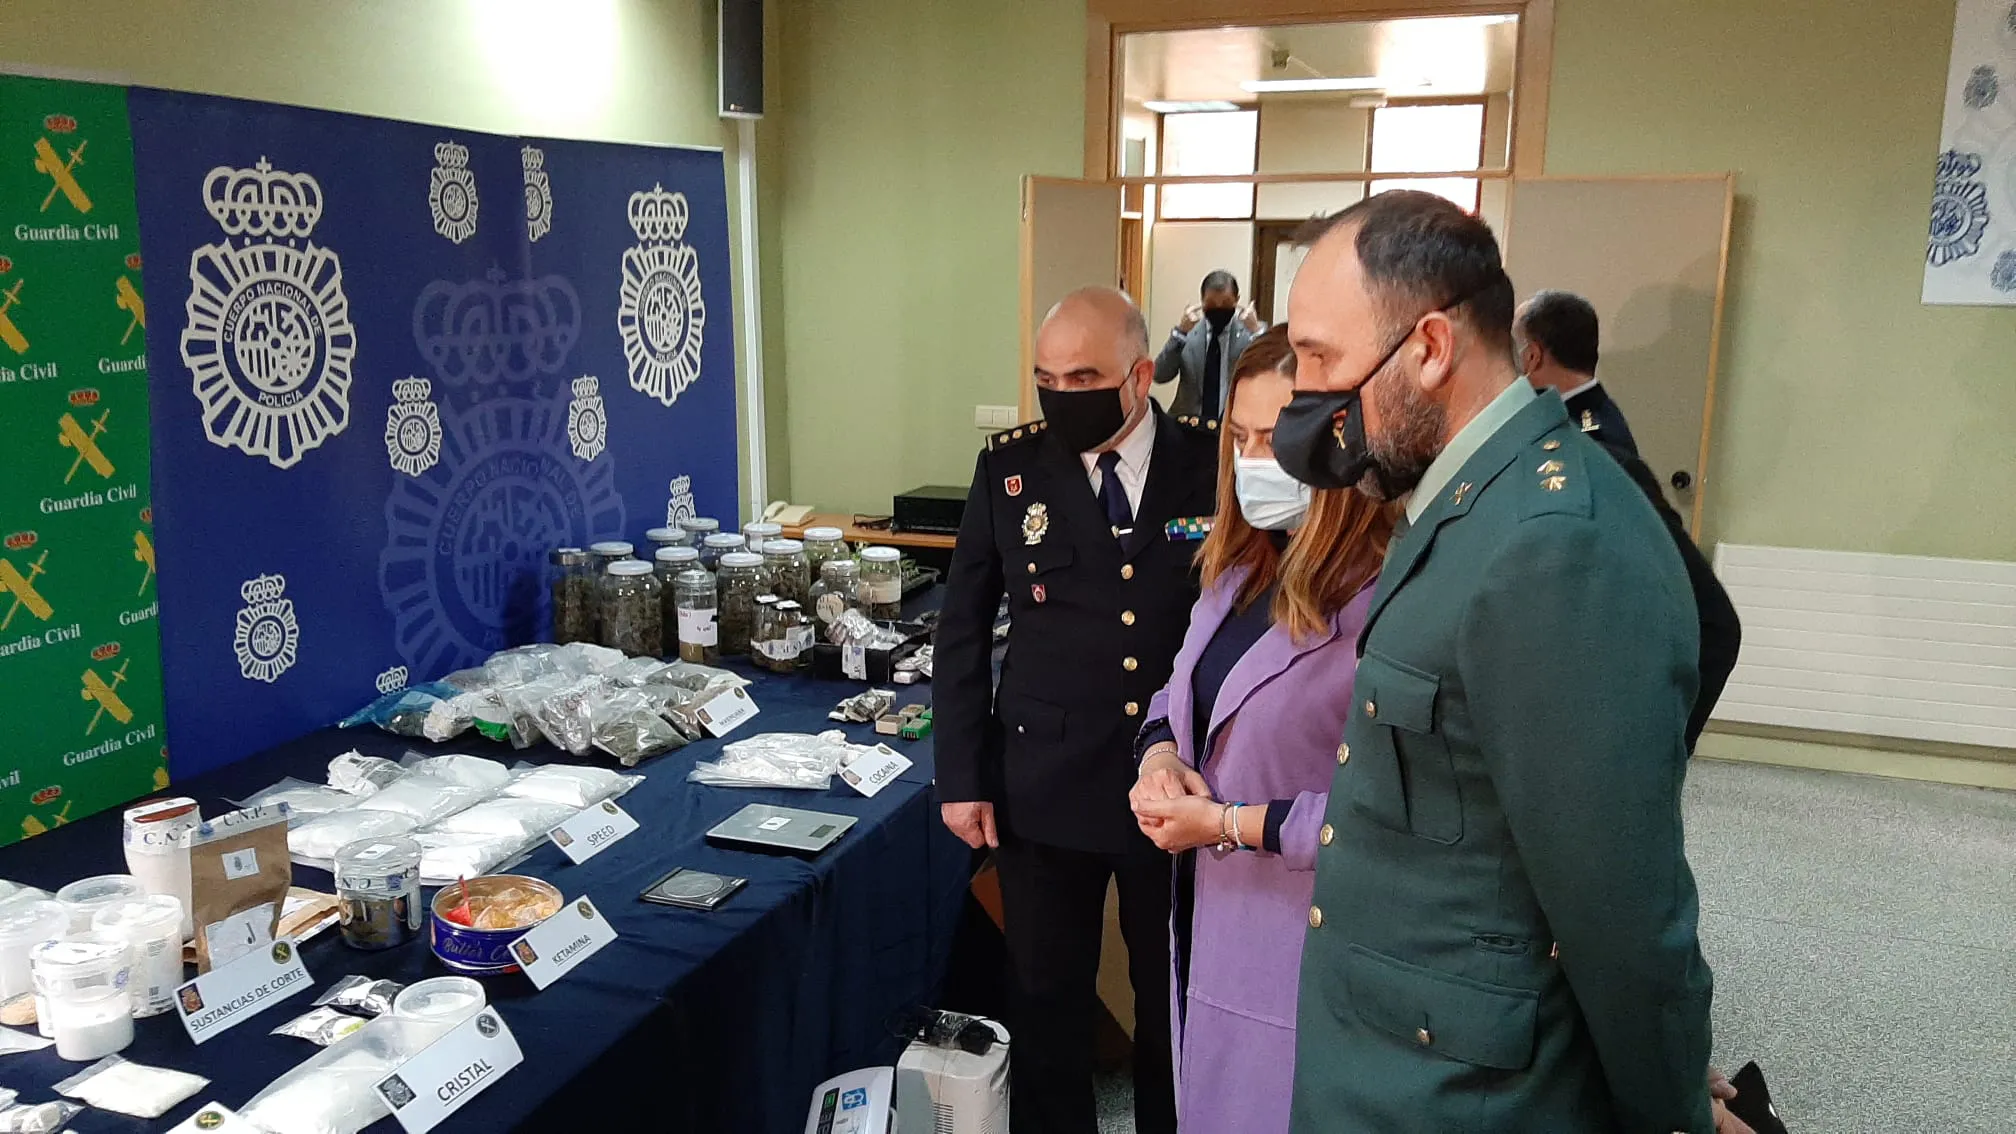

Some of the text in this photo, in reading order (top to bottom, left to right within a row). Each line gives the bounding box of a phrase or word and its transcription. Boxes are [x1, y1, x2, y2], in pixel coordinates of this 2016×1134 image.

[14, 224, 119, 241] Guardia Civil
[223, 282, 322, 342] CUERPO NACIONAL DE
[20, 362, 58, 381] Civil
[98, 354, 146, 374] Guardi
[258, 390, 304, 407] POLICIA
[40, 484, 137, 514] Guardia Civil
[0, 624, 81, 657] ardia Civil
[63, 724, 156, 767] Guardia Civil
[0, 770, 20, 790] vil
[869, 761, 898, 785] COCAINA
[586, 824, 616, 847] SPEED
[551, 934, 591, 965] KETAMINA
[190, 967, 305, 1031] SUSTANCIAS DE CORTE
[436, 1058, 493, 1102] CRISTAL
